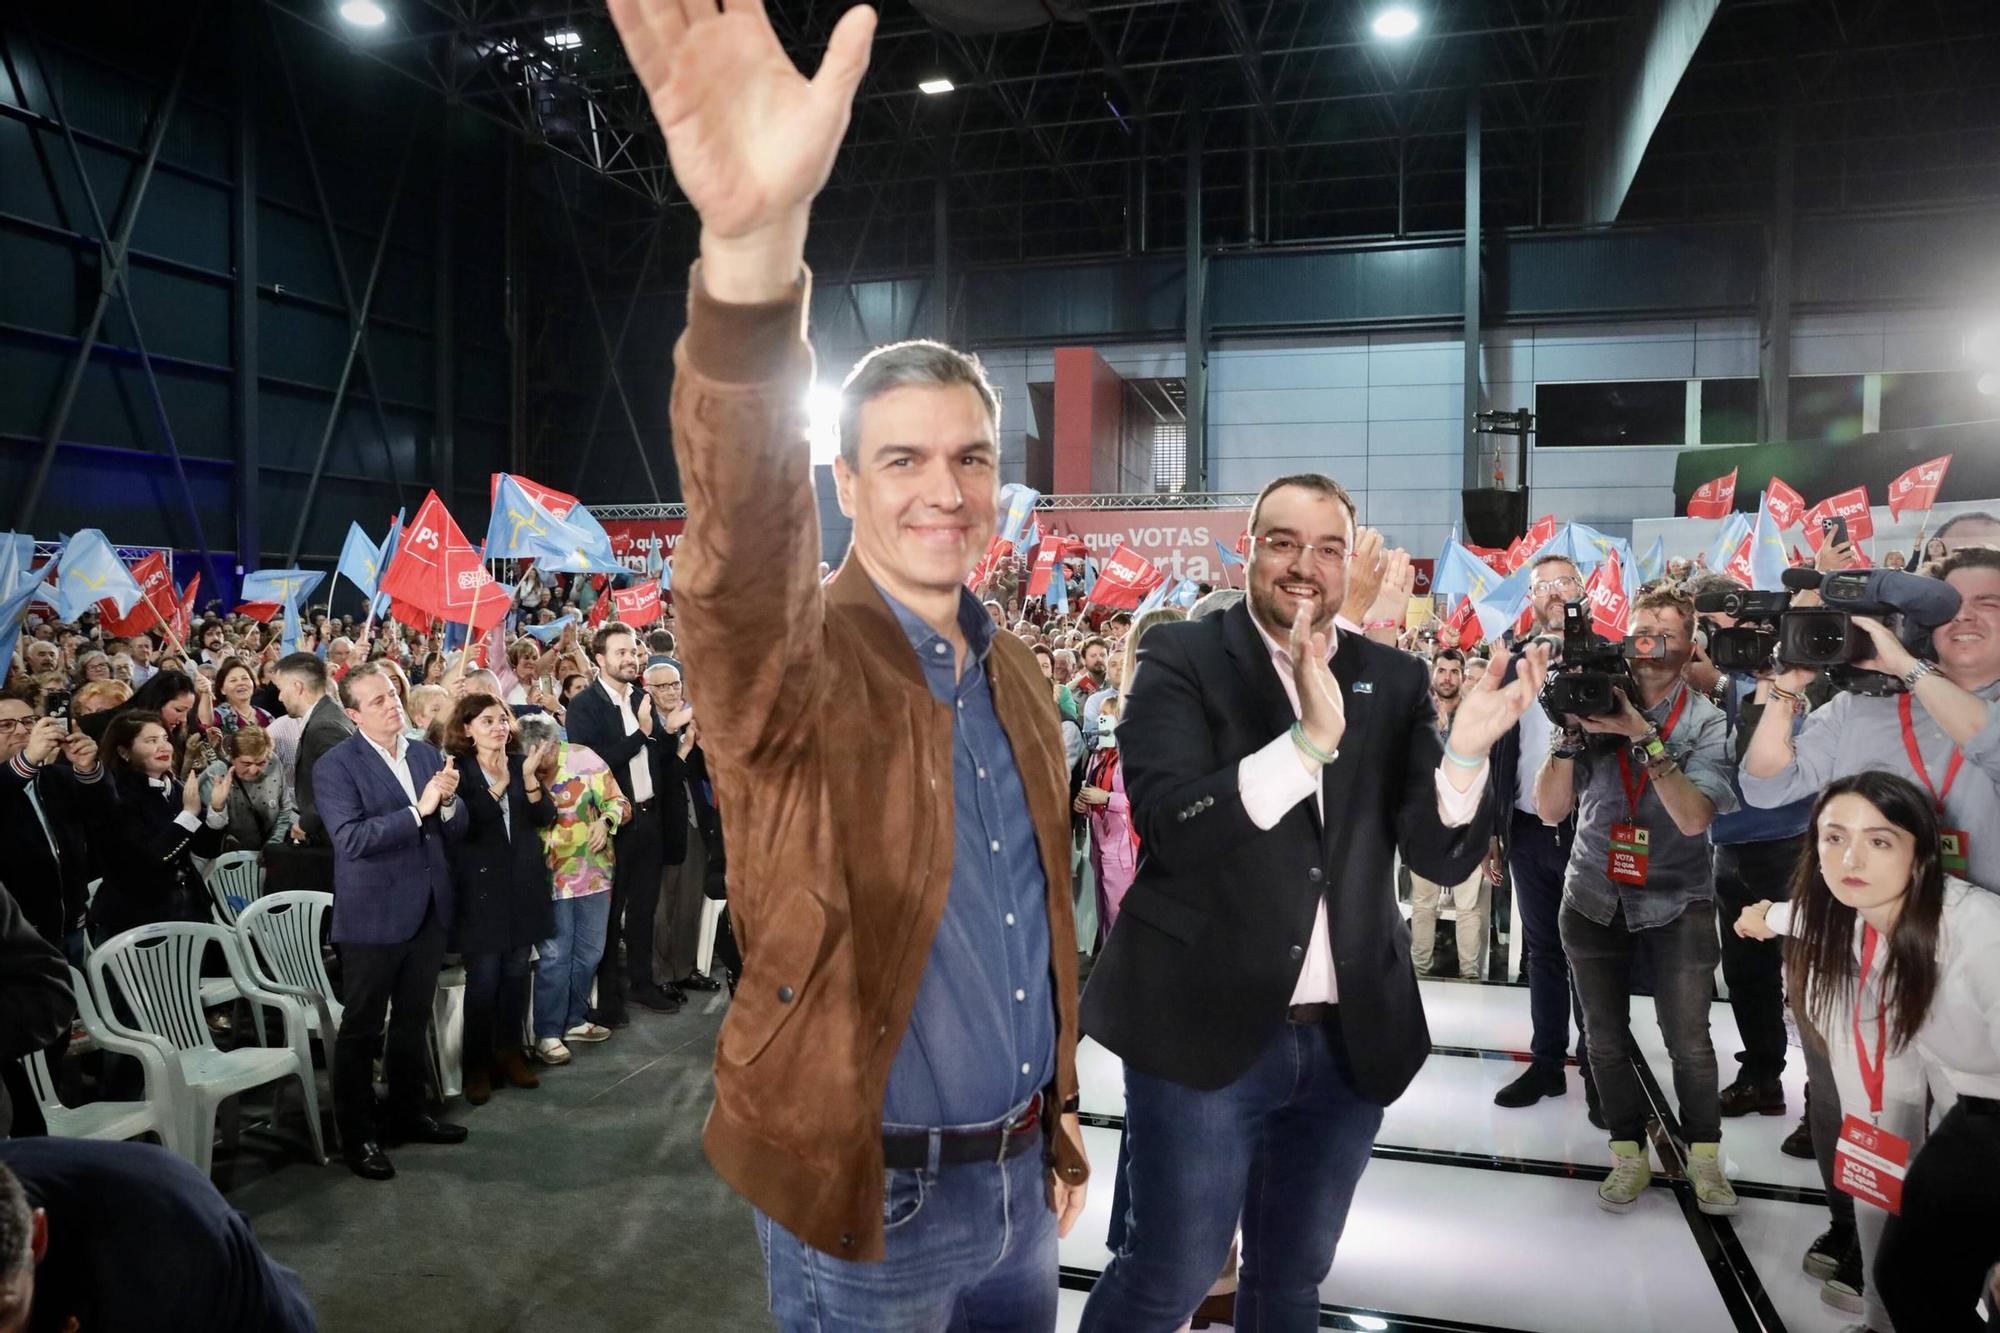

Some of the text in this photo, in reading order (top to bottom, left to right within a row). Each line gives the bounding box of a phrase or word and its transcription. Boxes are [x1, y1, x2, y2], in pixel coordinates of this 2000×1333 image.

[1083, 533, 1124, 552] que
[1129, 526, 1210, 548] VOTAS
[1107, 560, 1137, 582] PSOE
[1615, 853, 1635, 862] VOTA
[1844, 1158, 1877, 1181] VOTA
